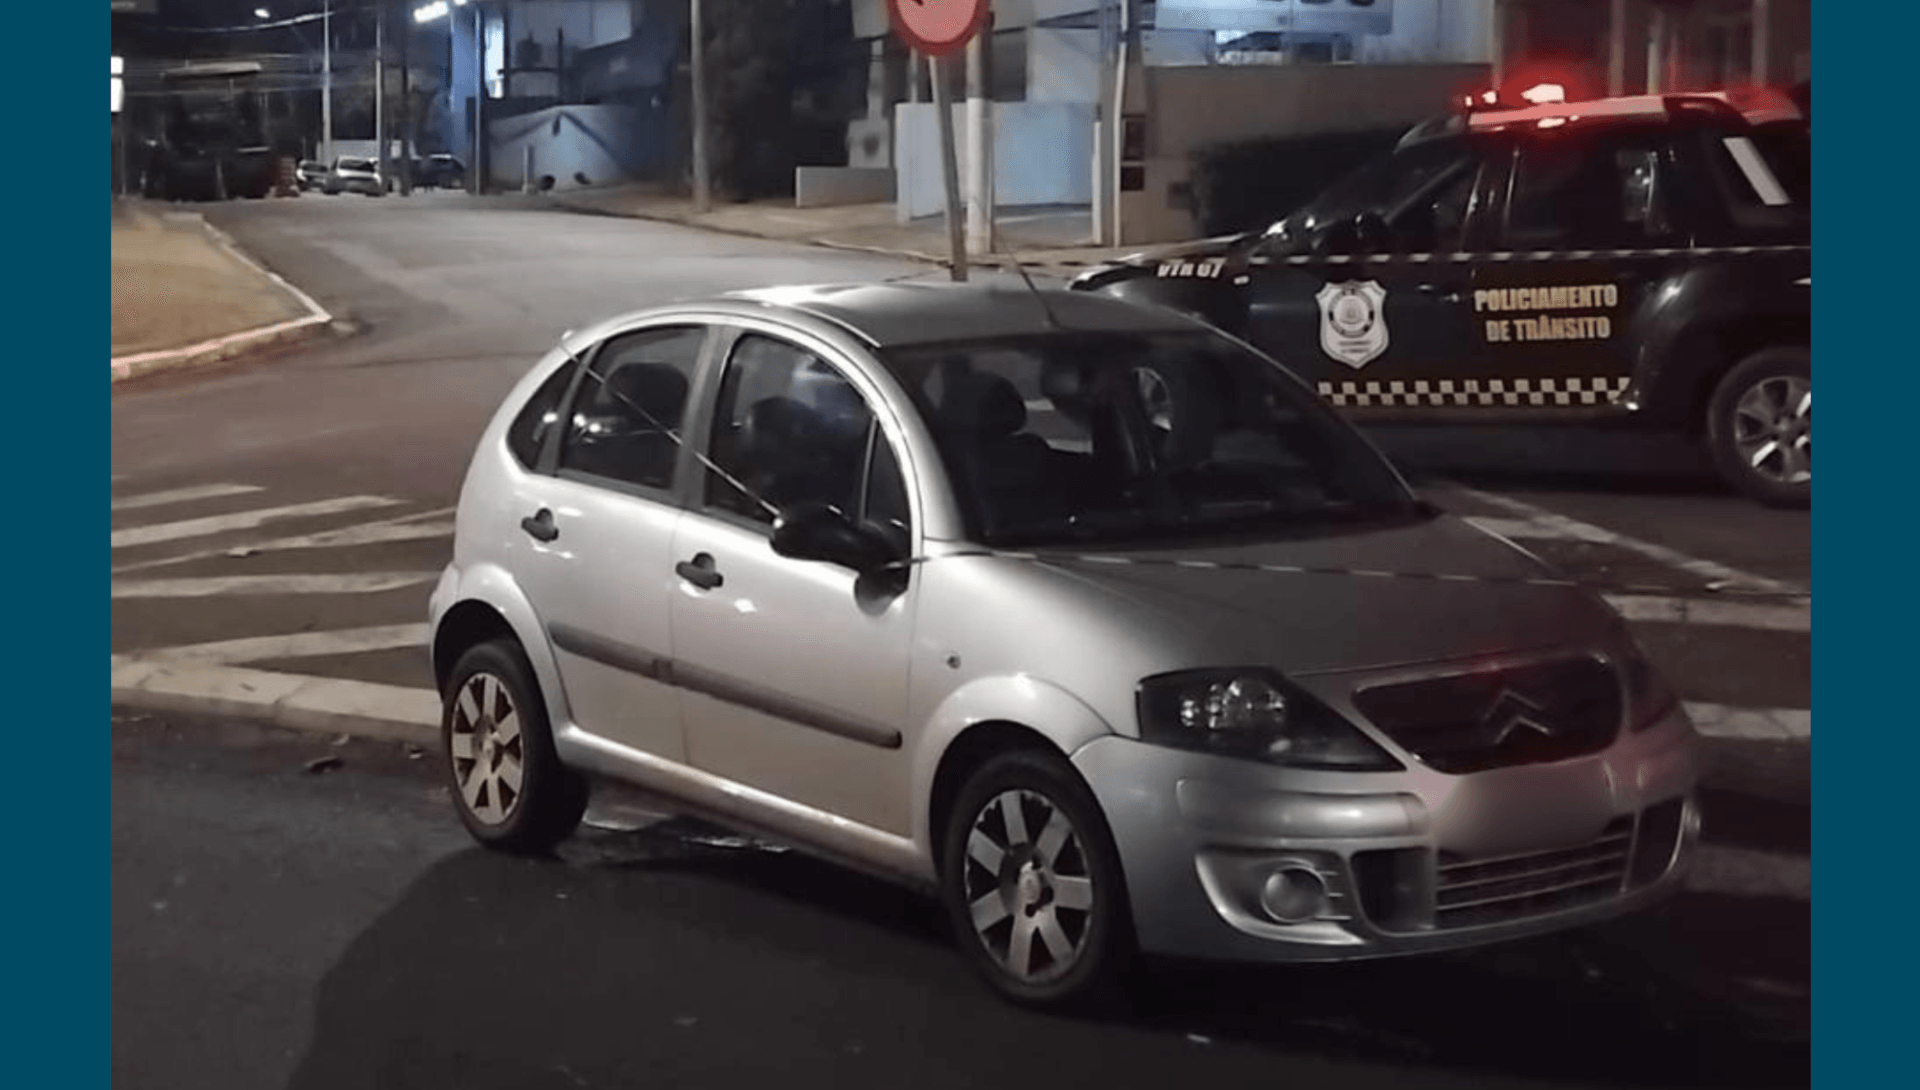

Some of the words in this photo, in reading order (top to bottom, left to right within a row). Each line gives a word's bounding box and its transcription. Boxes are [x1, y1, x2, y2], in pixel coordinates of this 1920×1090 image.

[1474, 284, 1618, 312] POLICIAMENTO
[1486, 320, 1511, 342] DE
[1513, 314, 1611, 341] TRÂNSITO
